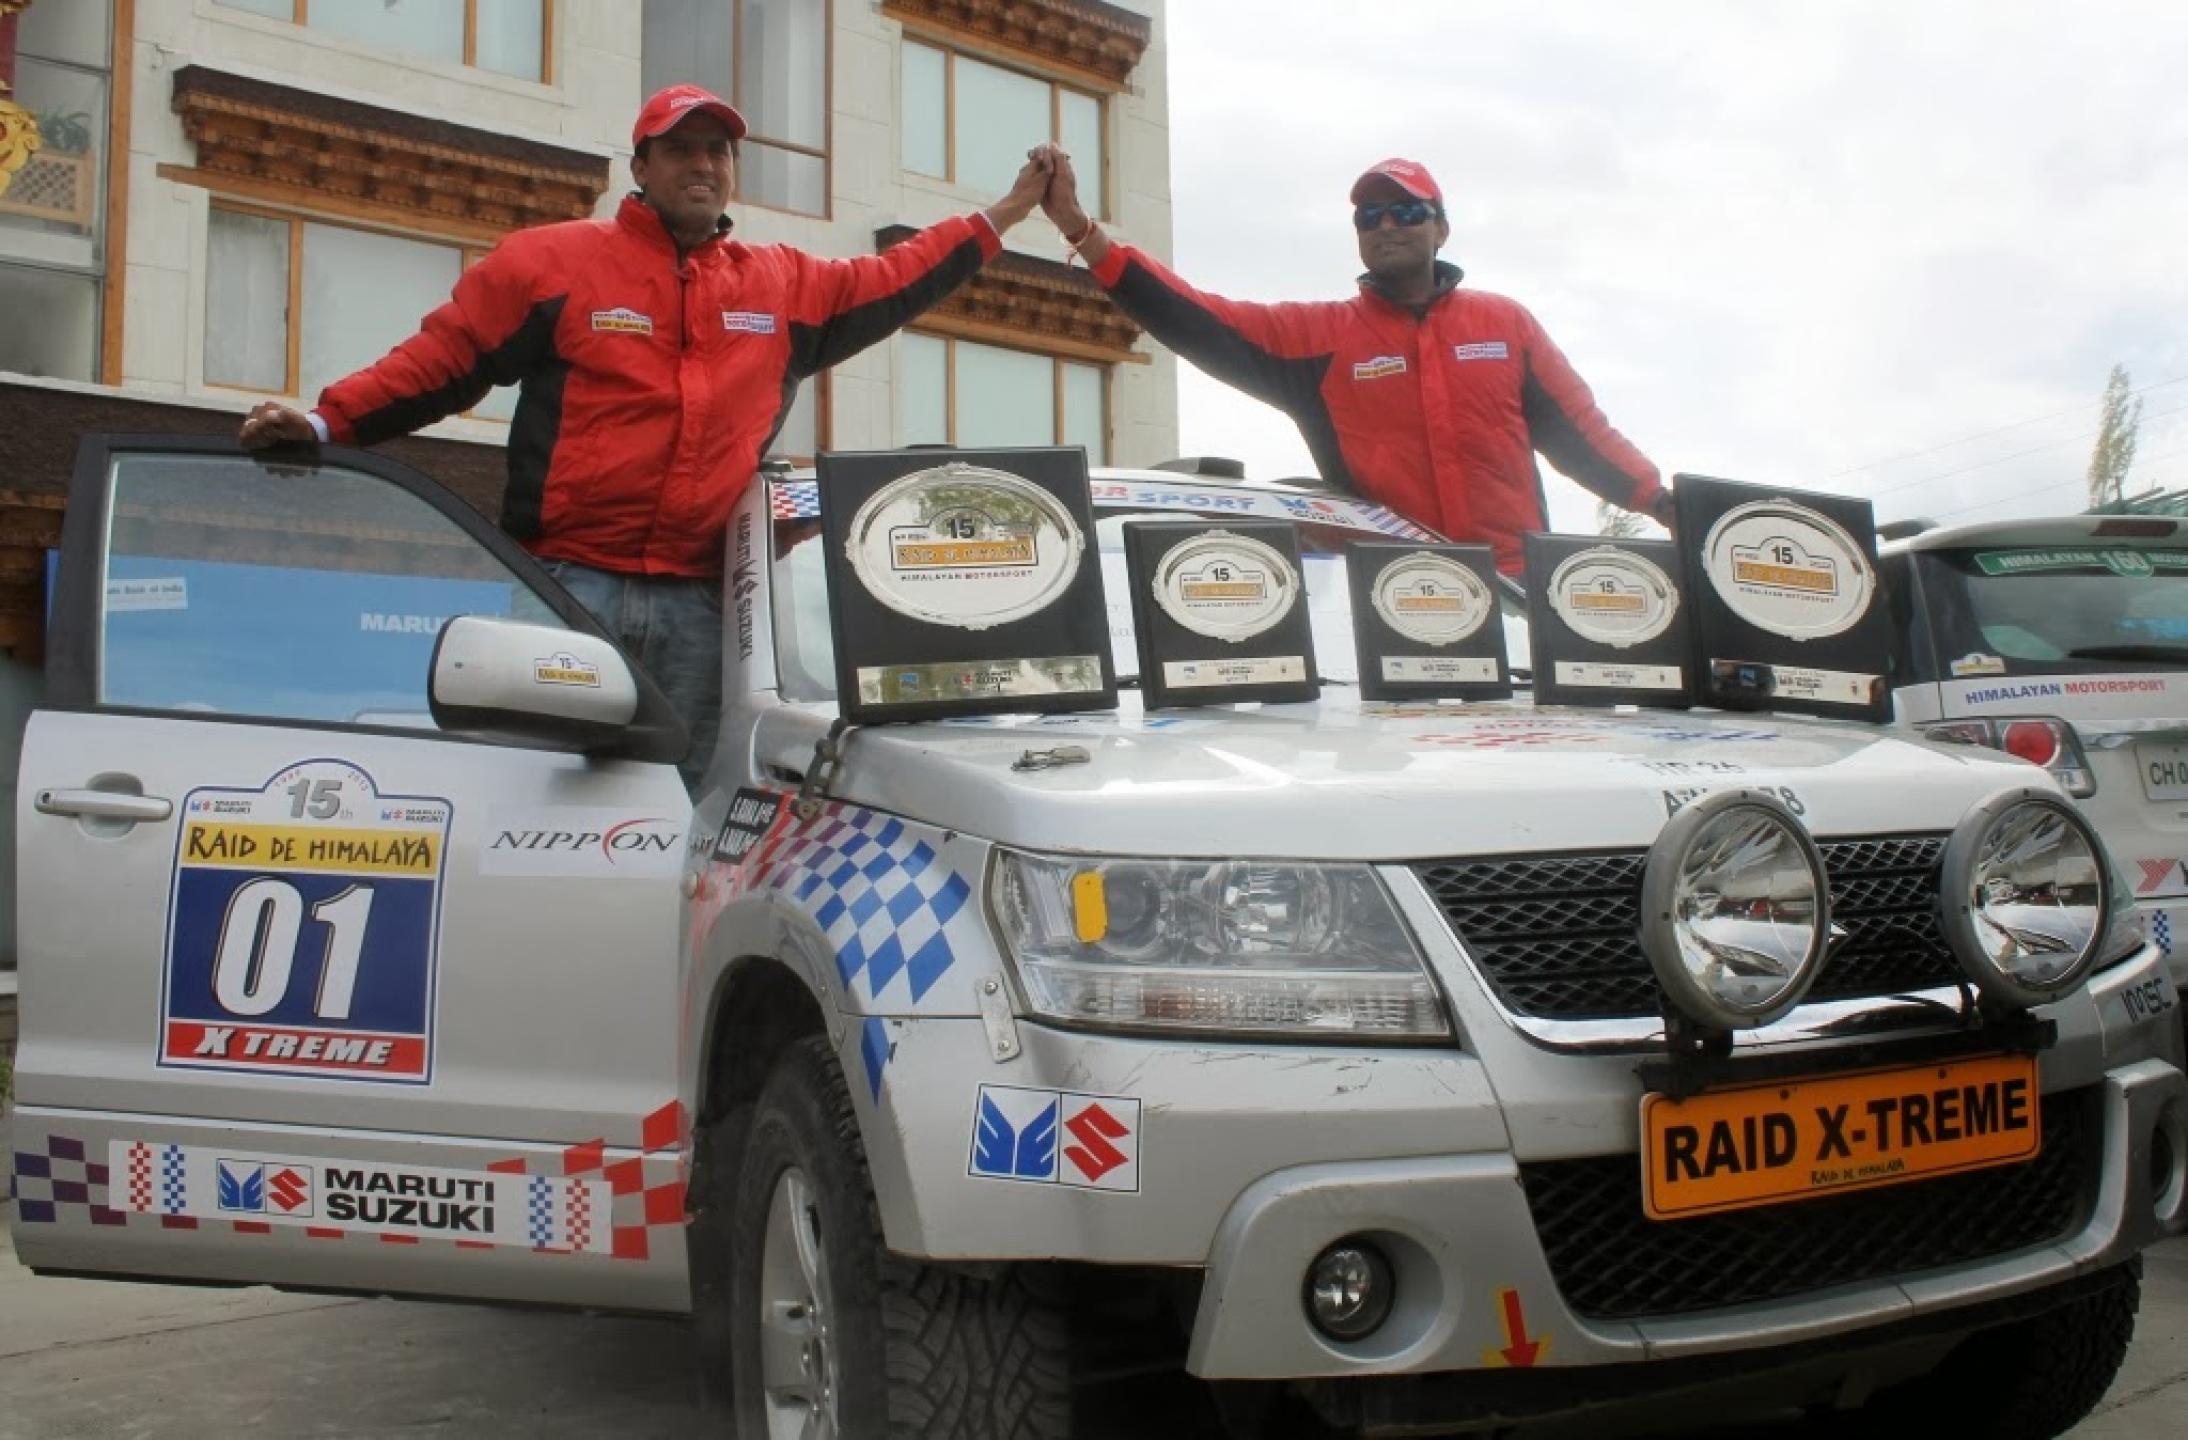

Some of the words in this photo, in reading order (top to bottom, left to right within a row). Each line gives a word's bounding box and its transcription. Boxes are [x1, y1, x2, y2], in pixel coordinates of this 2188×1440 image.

[1136, 492, 1255, 511] SPORT
[946, 518, 976, 539] 15
[1771, 546, 1794, 565] 15
[1212, 567, 1230, 582] 15
[1600, 580, 1616, 595] 15
[361, 612, 444, 634] MARU
[1965, 683, 2061, 705] HIMALAYAN
[2064, 679, 2166, 694] MOTORSPORT
[188, 826, 257, 859] RAID
[270, 836, 297, 863] DE
[309, 837, 431, 868] HIMALAYA
[490, 828, 682, 853] NIPPON
[211, 875, 375, 1020] 01
[194, 1026, 234, 1056] X
[245, 1032, 394, 1065] TREME
[1664, 1111, 1798, 1183] RAID
[1815, 1078, 2029, 1161] X-TREME
[1811, 1170, 1839, 1185] RAID
[1843, 1167, 1854, 1180] DE
[1858, 1157, 1905, 1177] HIMALAYA
[324, 1168, 495, 1202] MARUTI
[326, 1193, 495, 1234] SUZUKI
